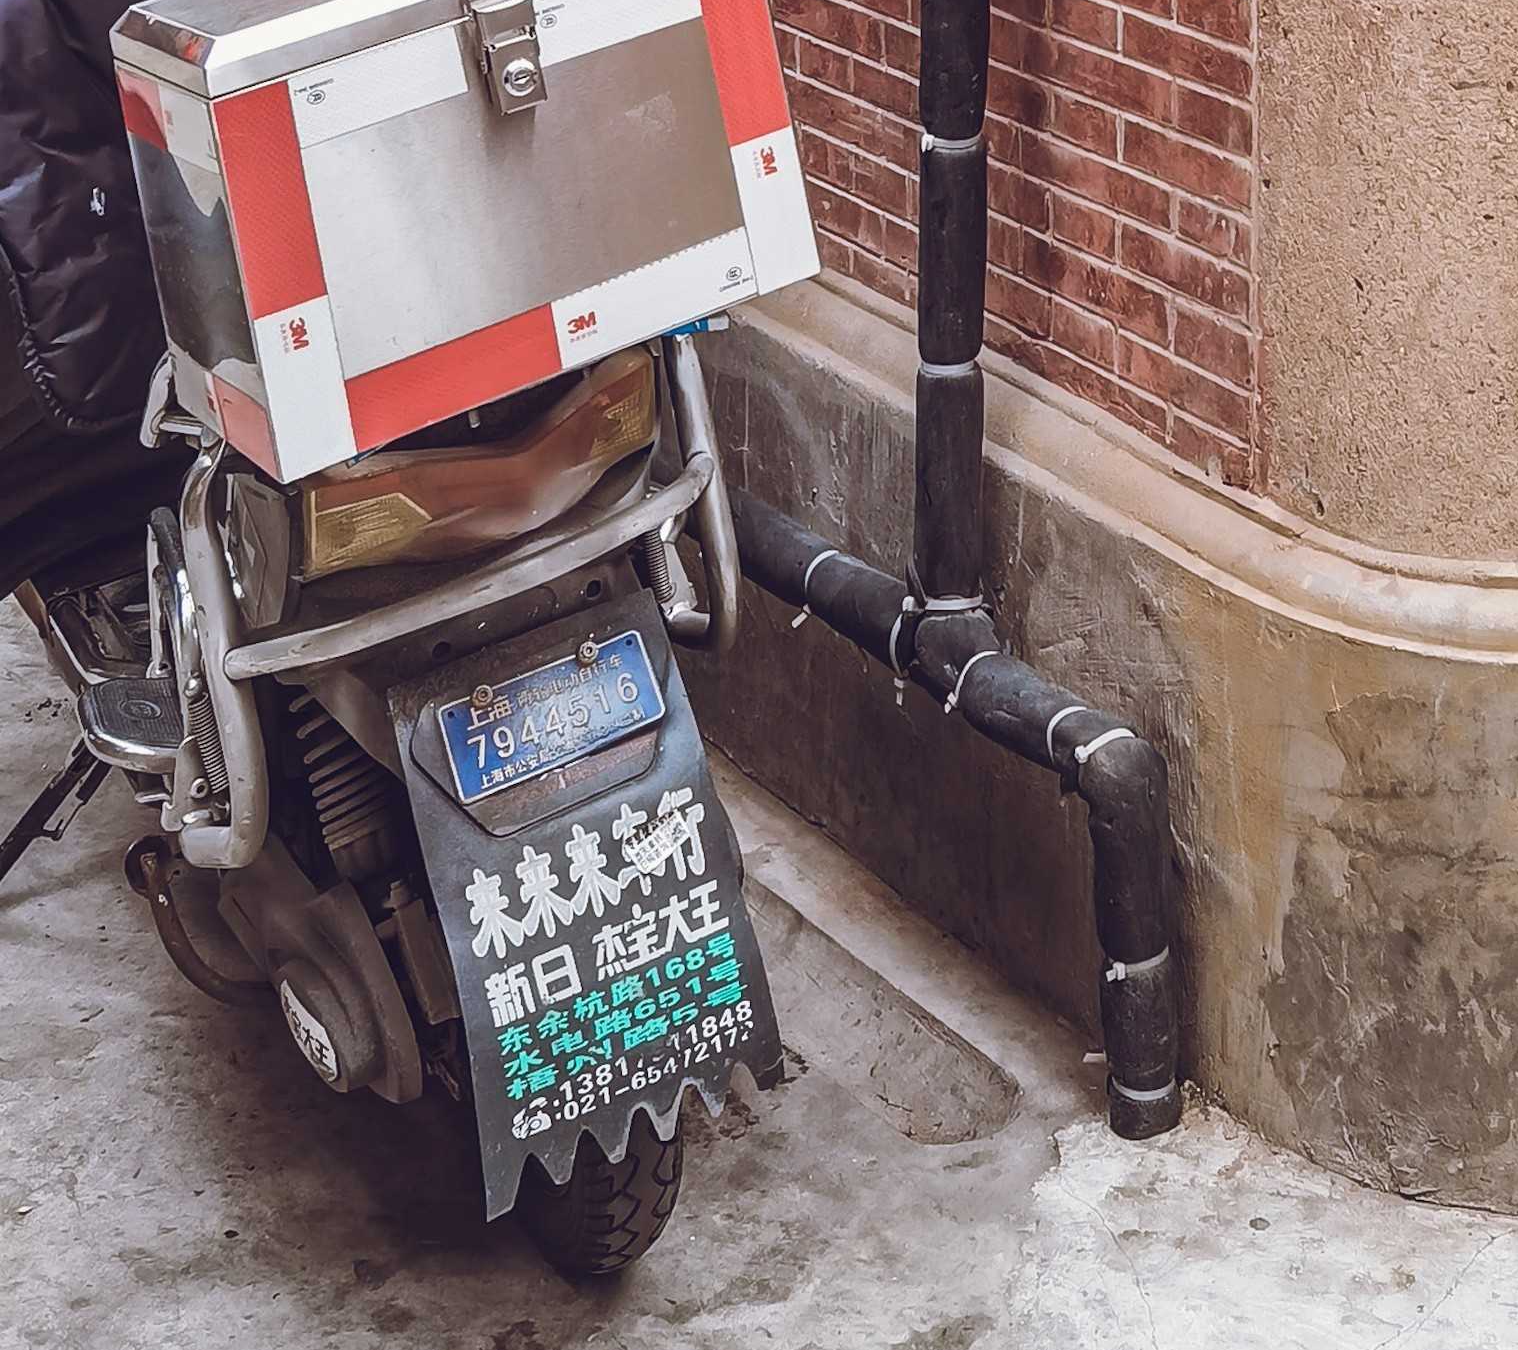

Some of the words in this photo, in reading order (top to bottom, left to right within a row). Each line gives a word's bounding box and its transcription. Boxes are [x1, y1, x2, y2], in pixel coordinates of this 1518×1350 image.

[760, 146, 778, 176] 3M
[289, 317, 309, 351] 3M
[567, 311, 597, 335] 3M
[467, 694, 513, 731] 上海
[467, 672, 639, 770] 7944516
[484, 943, 583, 1028] 新日
[497, 932, 736, 1056] 东余杭路168号
[503, 958, 744, 1078] 水电路651号
